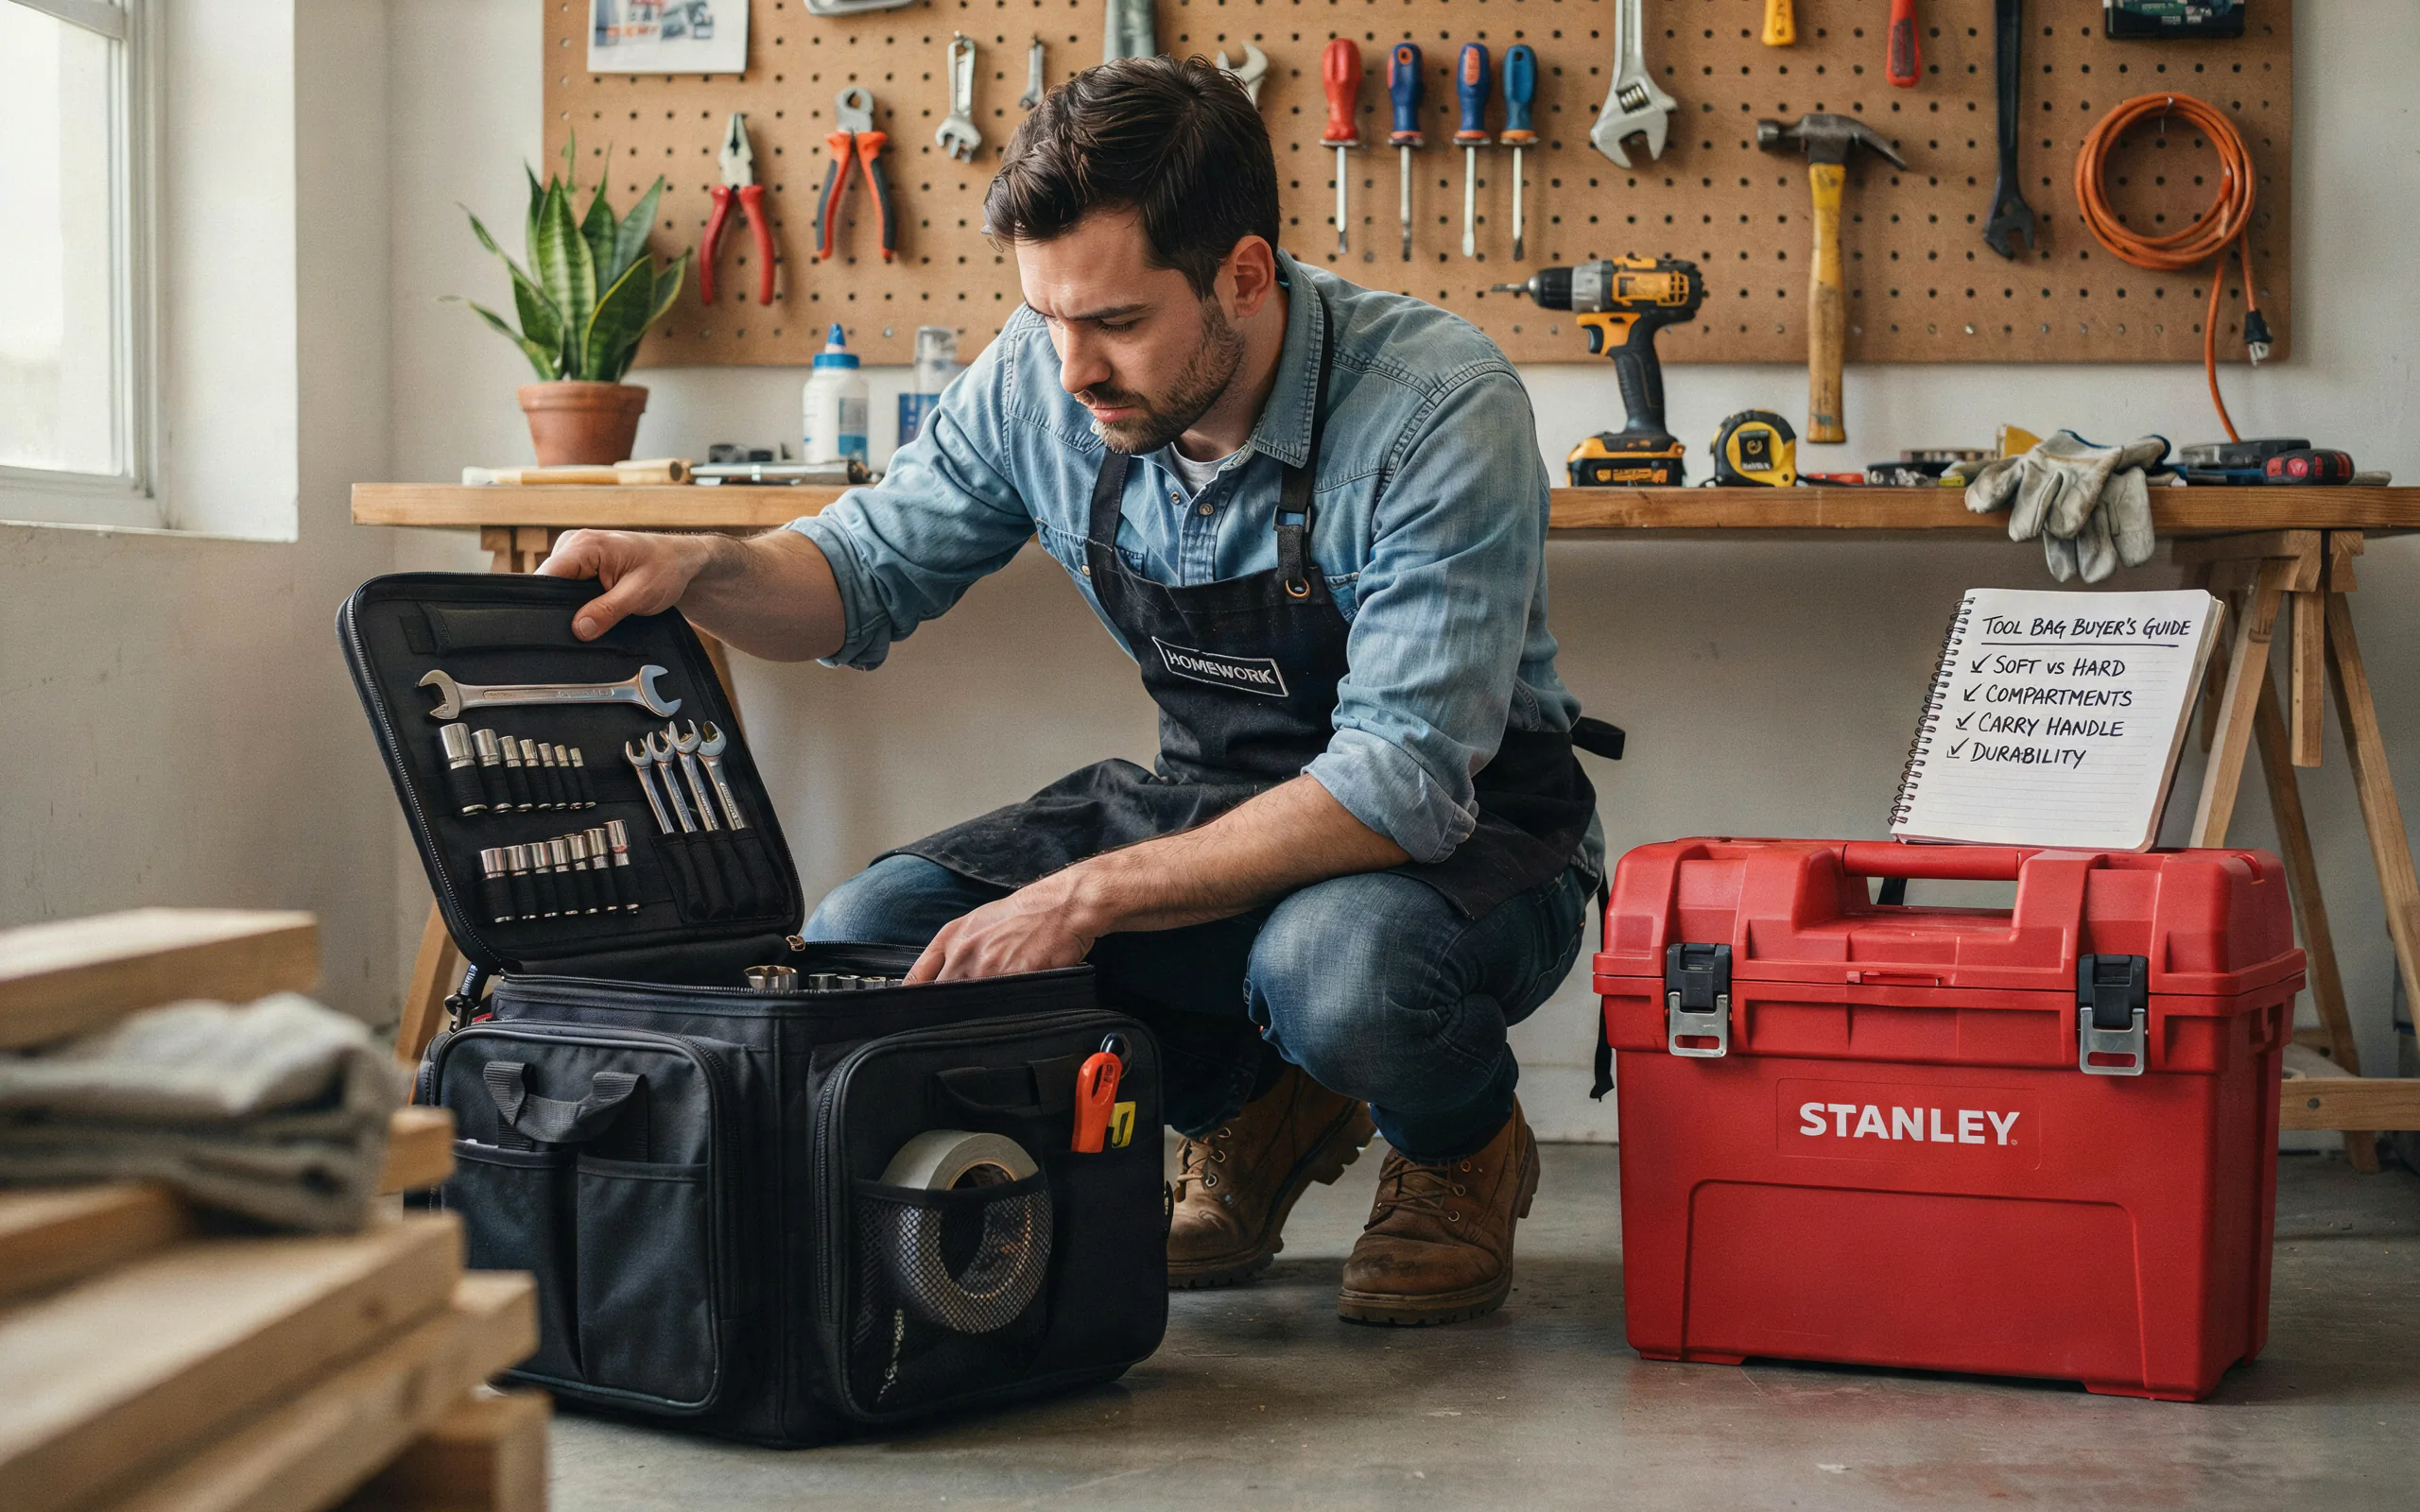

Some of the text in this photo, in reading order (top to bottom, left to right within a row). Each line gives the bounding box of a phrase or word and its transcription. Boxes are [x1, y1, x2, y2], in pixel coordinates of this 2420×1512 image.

[1982, 615, 2191, 639] TOOL BAG BUYER'S GUIDE
[1167, 649, 1276, 683] HOMEWORK
[1993, 655, 2041, 675] SOFT
[2072, 660, 2125, 677] HARD
[1986, 684, 2133, 707] COMPARTMENTS
[1979, 713, 2124, 736] CARRY HANDLE
[1970, 742, 2086, 769] DURABILITY
[1799, 1102, 2020, 1145] STANLEY
